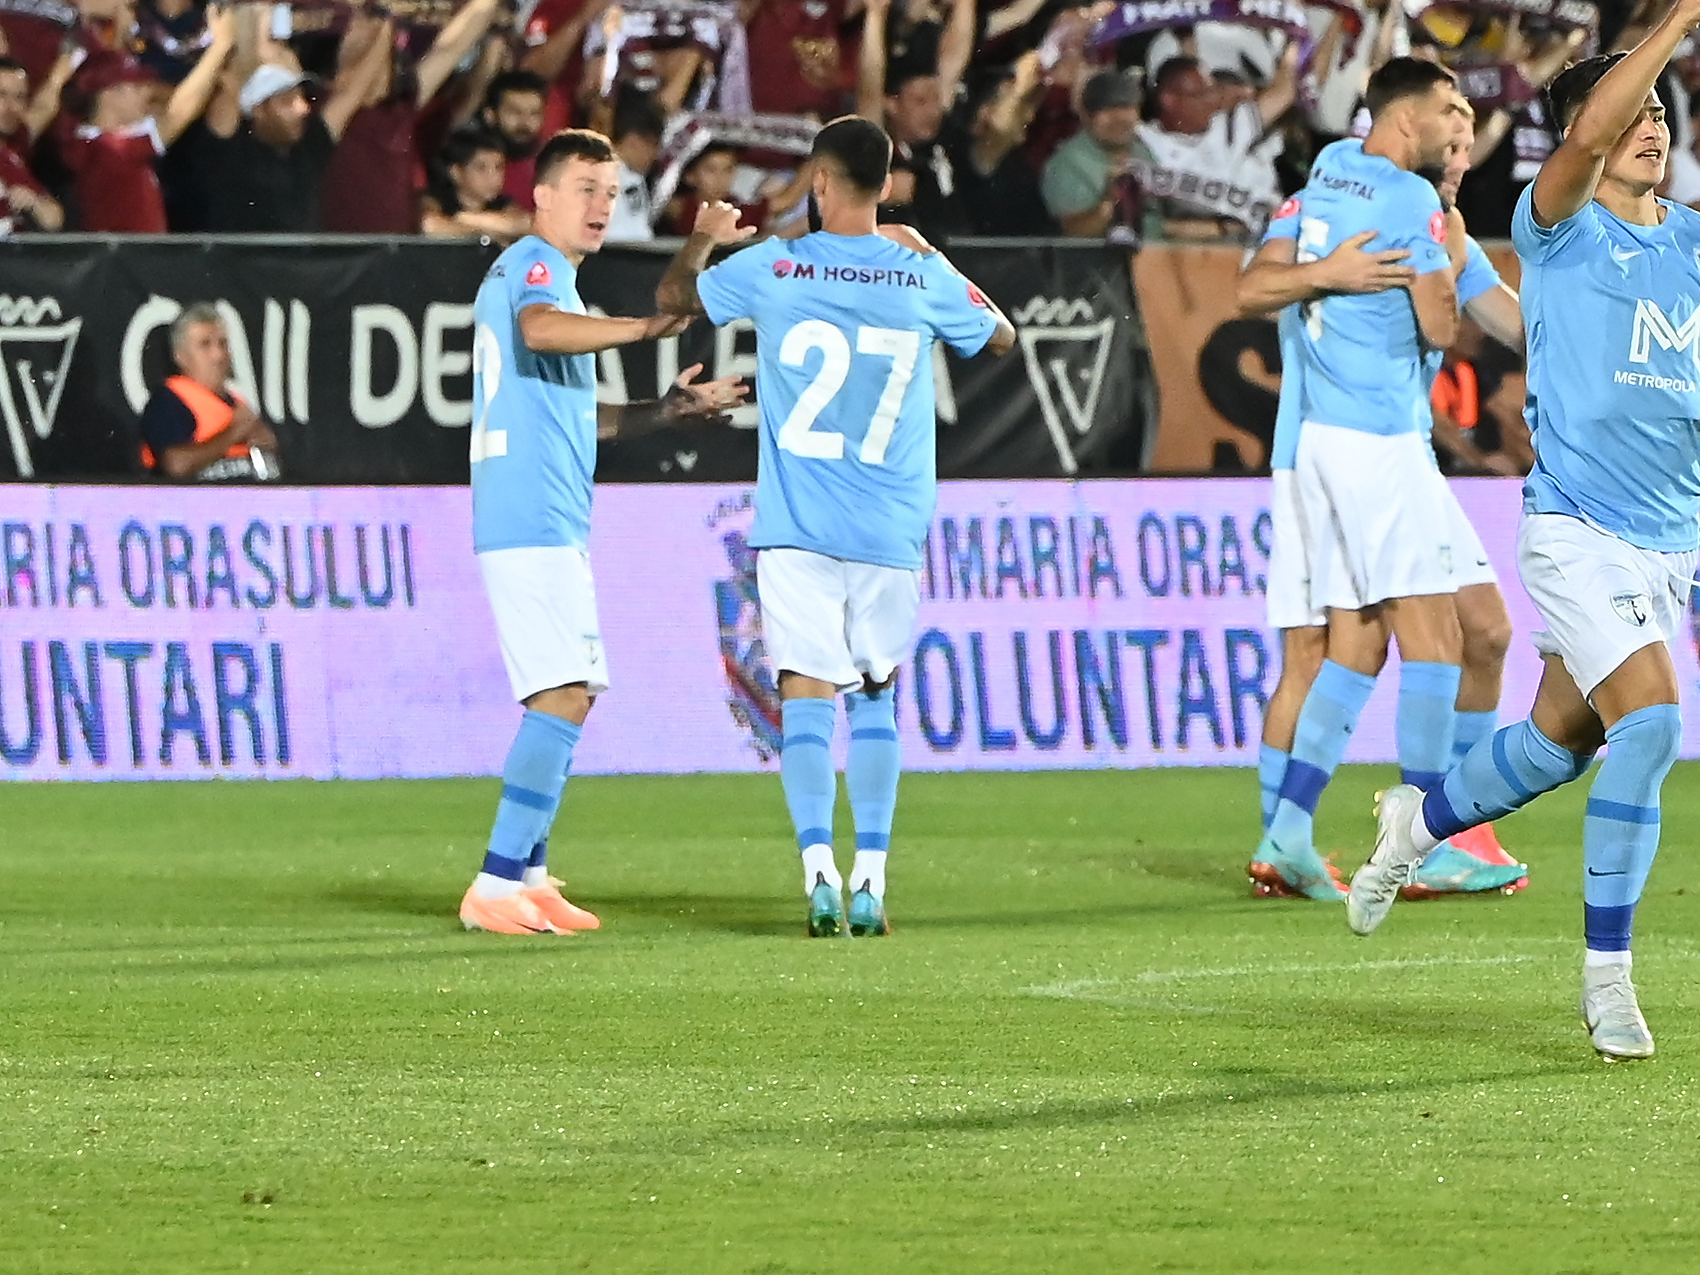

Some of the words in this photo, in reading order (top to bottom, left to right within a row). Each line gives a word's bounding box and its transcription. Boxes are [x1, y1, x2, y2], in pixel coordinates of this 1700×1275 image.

[823, 265, 928, 290] HOSPITAL
[778, 319, 920, 464] 27
[1613, 369, 1696, 393] METROPOLA
[0, 522, 102, 608] RIA
[898, 626, 1272, 754] OLUNTAR
